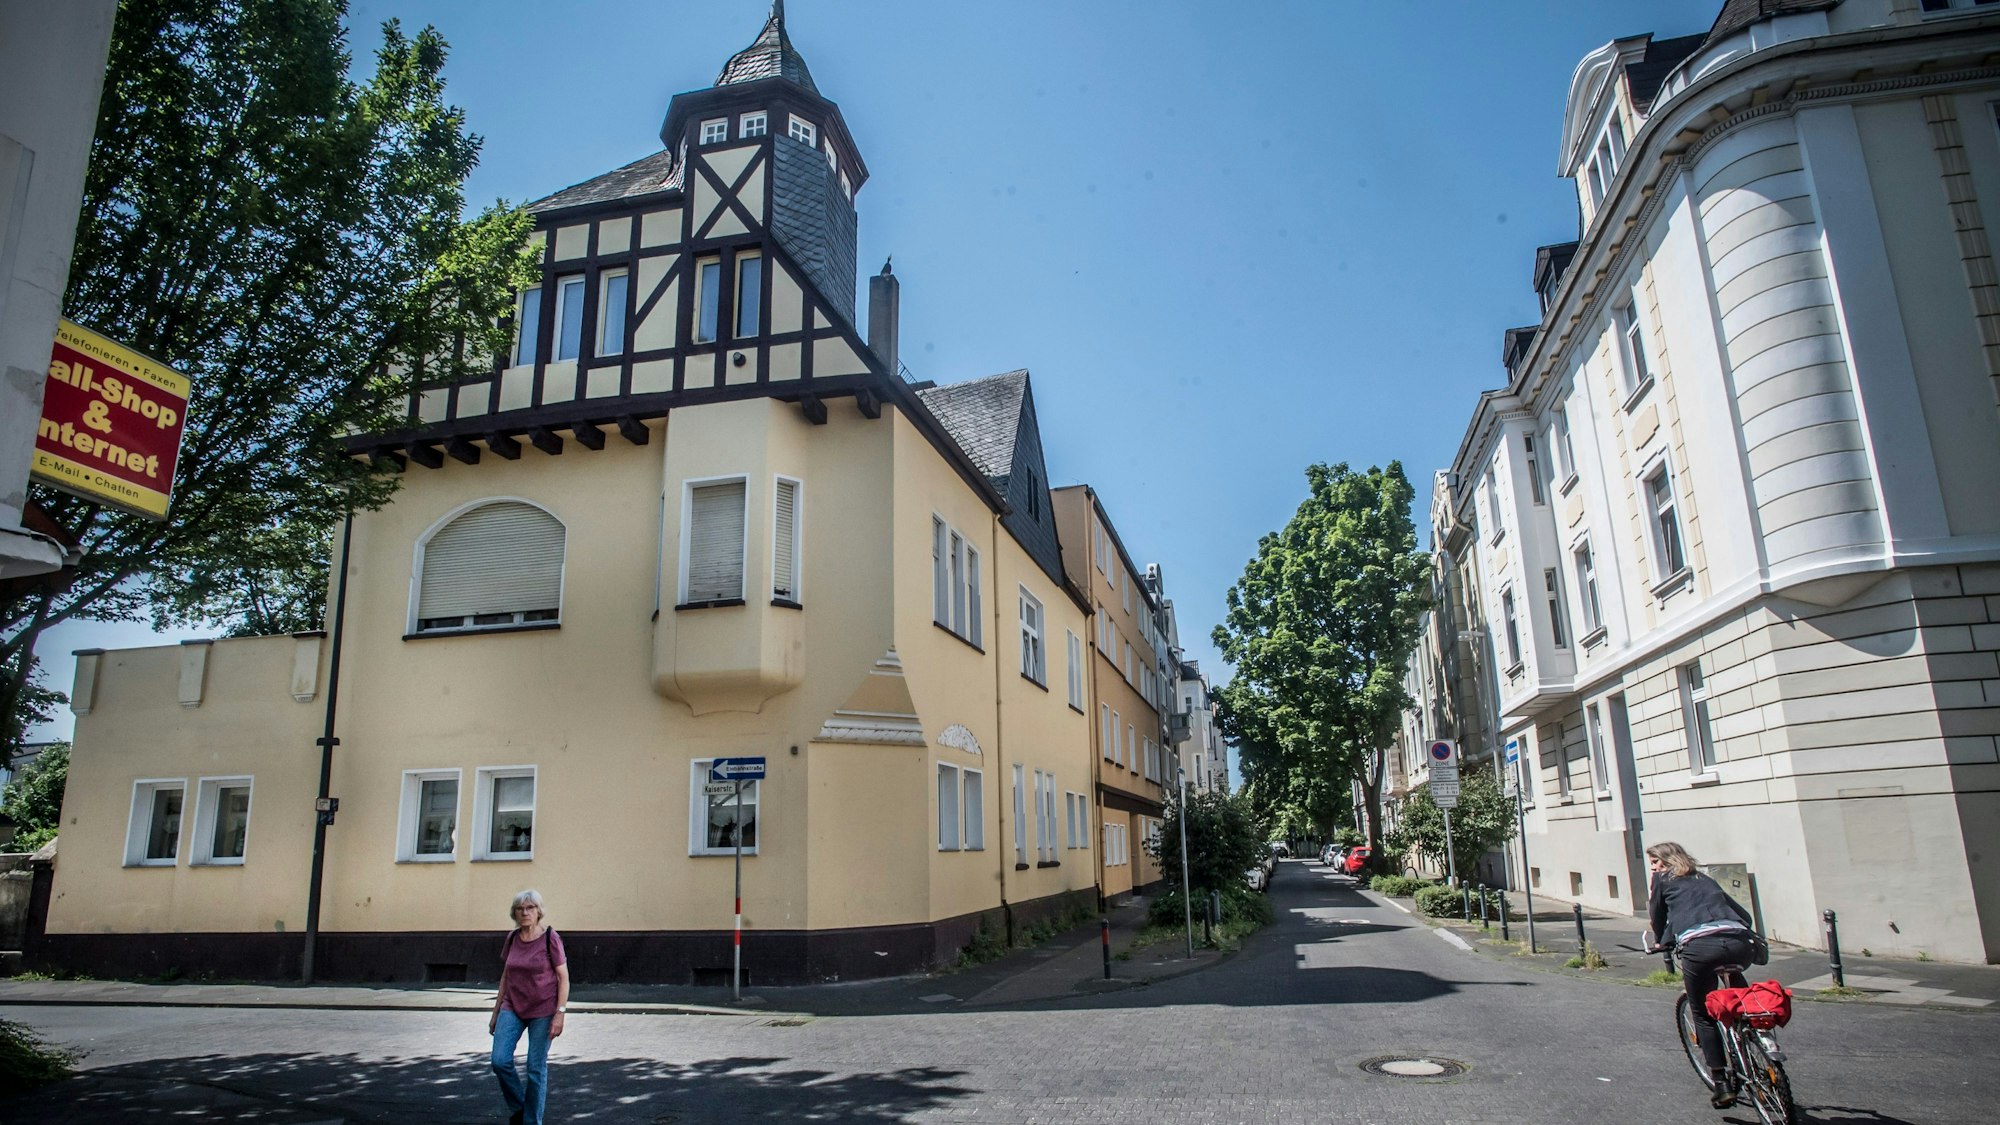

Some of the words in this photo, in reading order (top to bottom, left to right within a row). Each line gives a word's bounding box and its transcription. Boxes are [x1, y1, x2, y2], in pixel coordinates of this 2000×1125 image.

[55, 328, 129, 368] Telefonieren
[143, 368, 176, 389] Faxen
[49, 359, 177, 429] all-Shop
[82, 400, 113, 434] &
[38, 417, 158, 478] nternet
[39, 456, 80, 479] E-Mail
[95, 476, 139, 499] Chatten
[704, 784, 733, 793] Kaiserstr.
